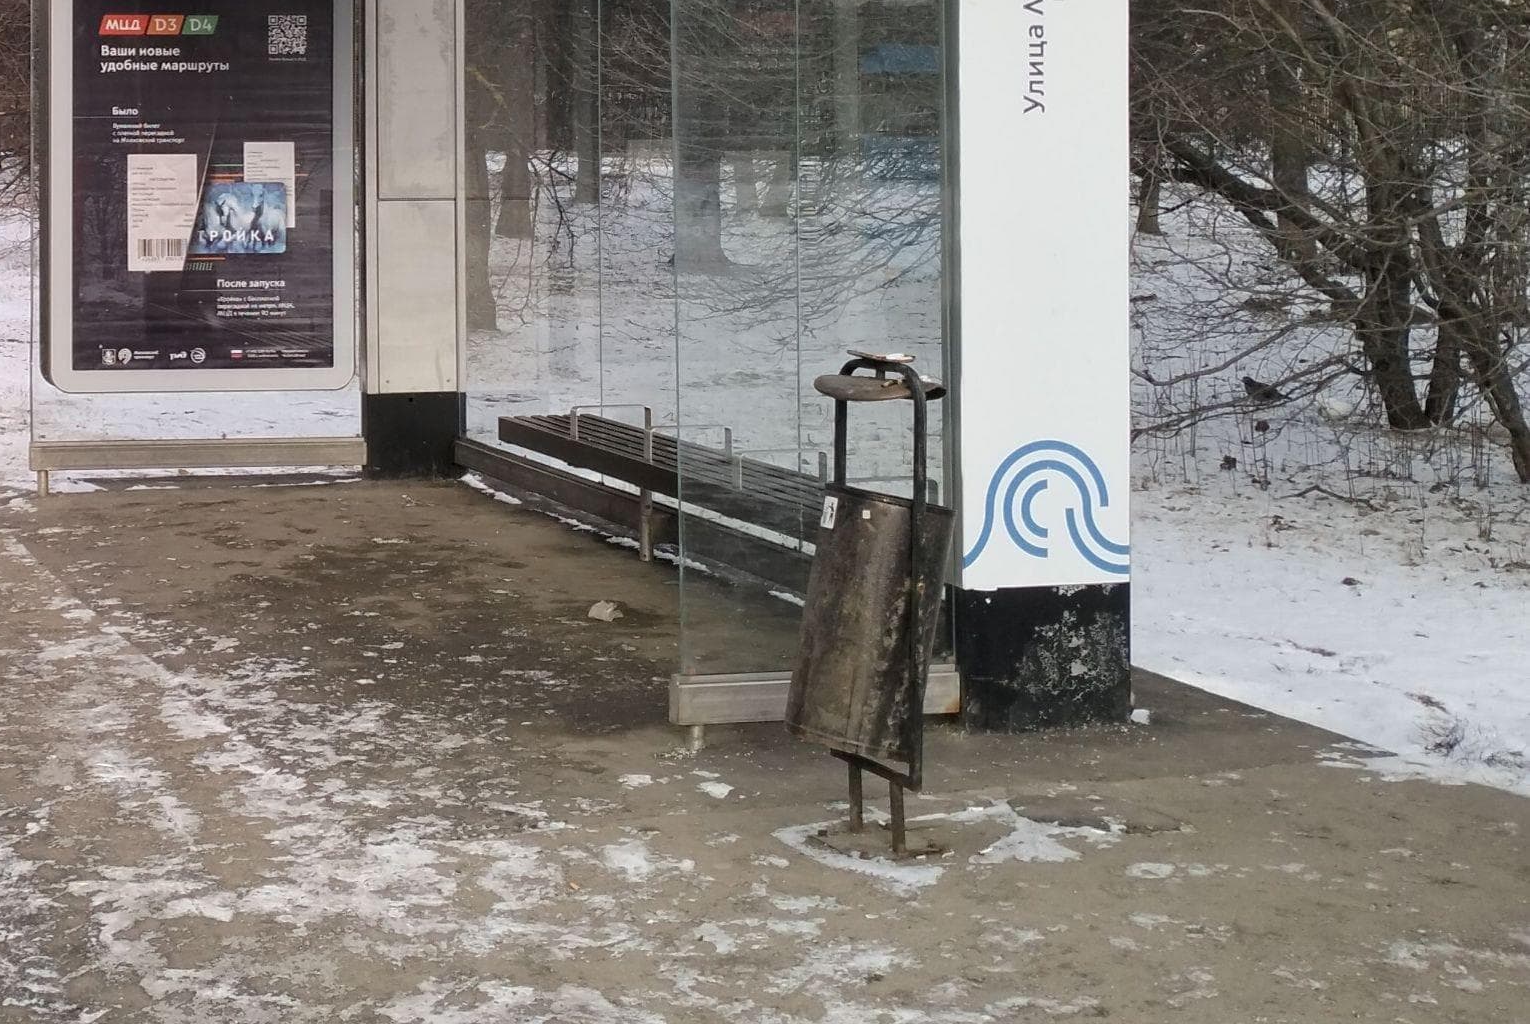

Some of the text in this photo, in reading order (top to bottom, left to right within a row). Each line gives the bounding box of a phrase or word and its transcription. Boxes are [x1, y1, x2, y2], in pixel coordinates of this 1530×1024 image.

[105, 18, 212, 32] МЦД D3 D4
[100, 45, 181, 57] Ваши новые
[100, 59, 230, 74] удобные маршруты
[1023, 24, 1047, 114] Улица
[112, 106, 139, 116] Было
[197, 227, 275, 242] ТРОЙКА
[216, 278, 287, 289] После запуска
